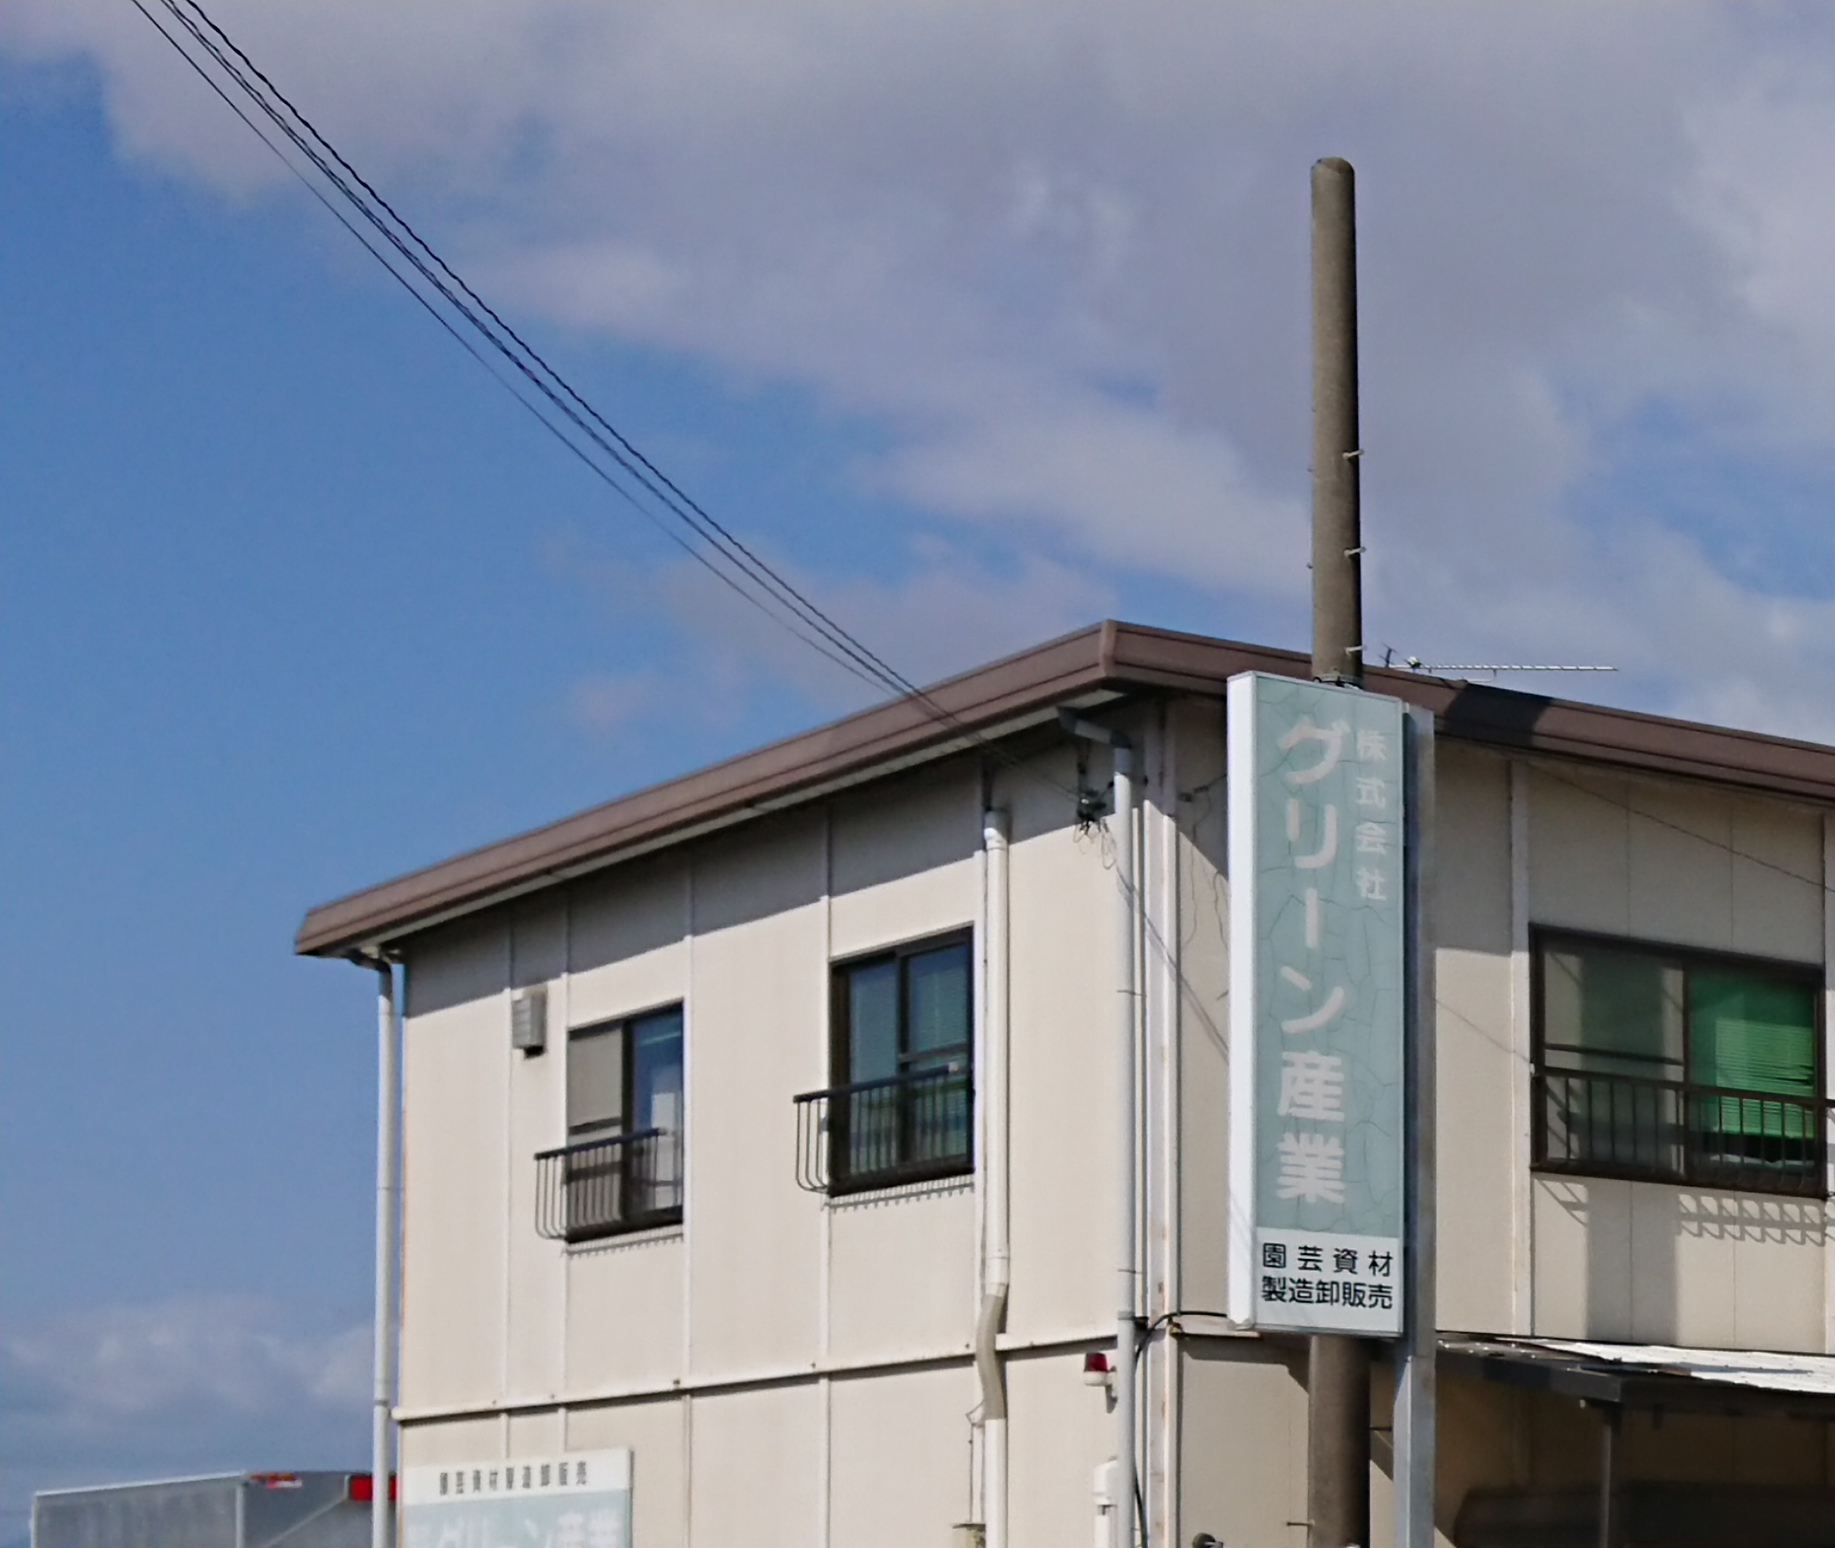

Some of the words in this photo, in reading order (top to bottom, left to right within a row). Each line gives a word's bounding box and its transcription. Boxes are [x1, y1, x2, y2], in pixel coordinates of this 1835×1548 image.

[1277, 716, 1350, 1204] グリーン産業
[1262, 1242, 1393, 1277] 園芸資材
[1261, 1275, 1393, 1309] 製造卸販売
